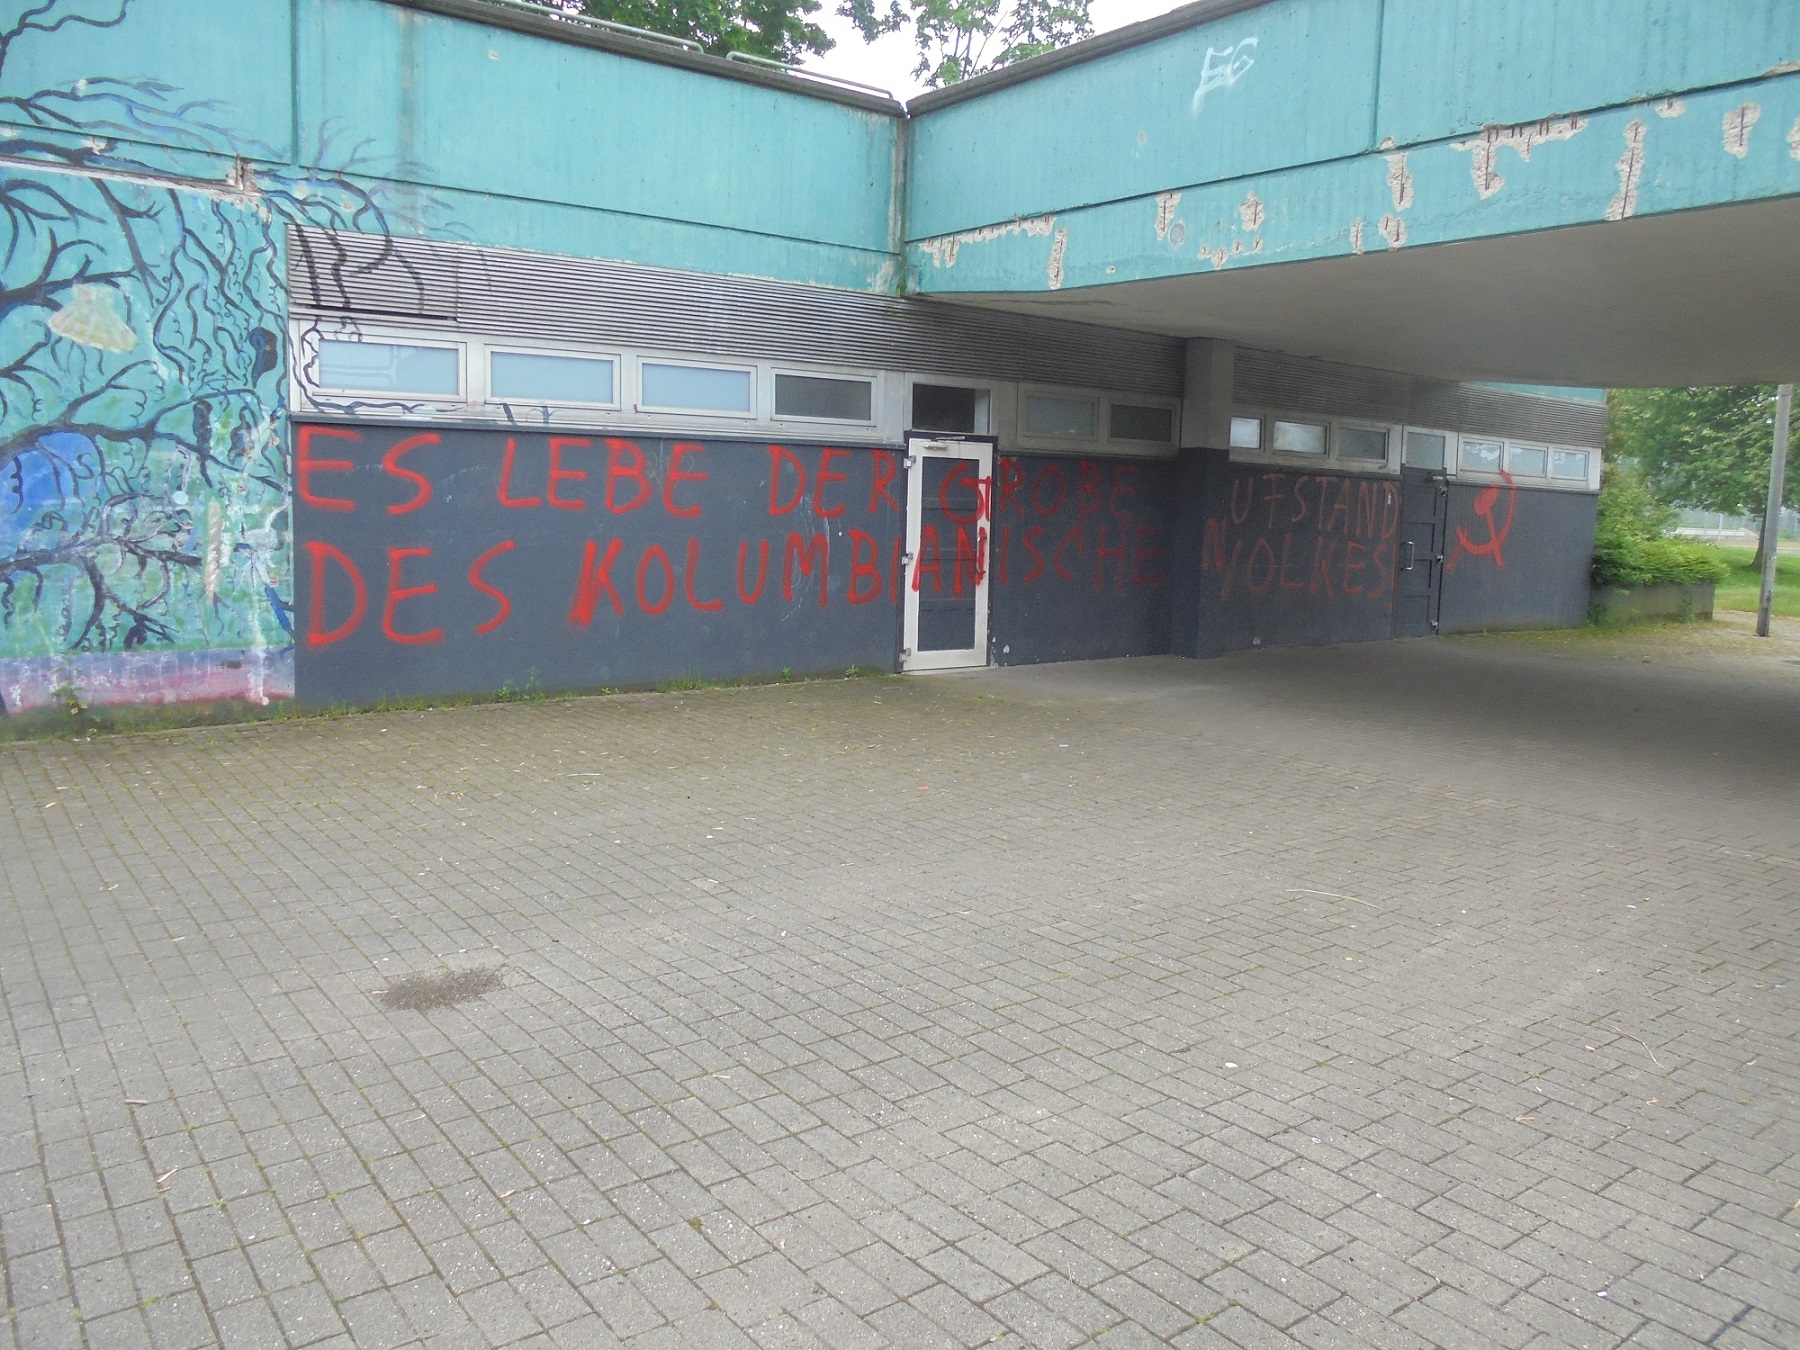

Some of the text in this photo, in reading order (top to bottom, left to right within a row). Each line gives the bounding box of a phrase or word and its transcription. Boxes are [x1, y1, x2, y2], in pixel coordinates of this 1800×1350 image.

[297, 425, 442, 516] ES
[498, 437, 709, 518] LEBE
[767, 446, 899, 519] DER
[303, 539, 516, 648] DES
